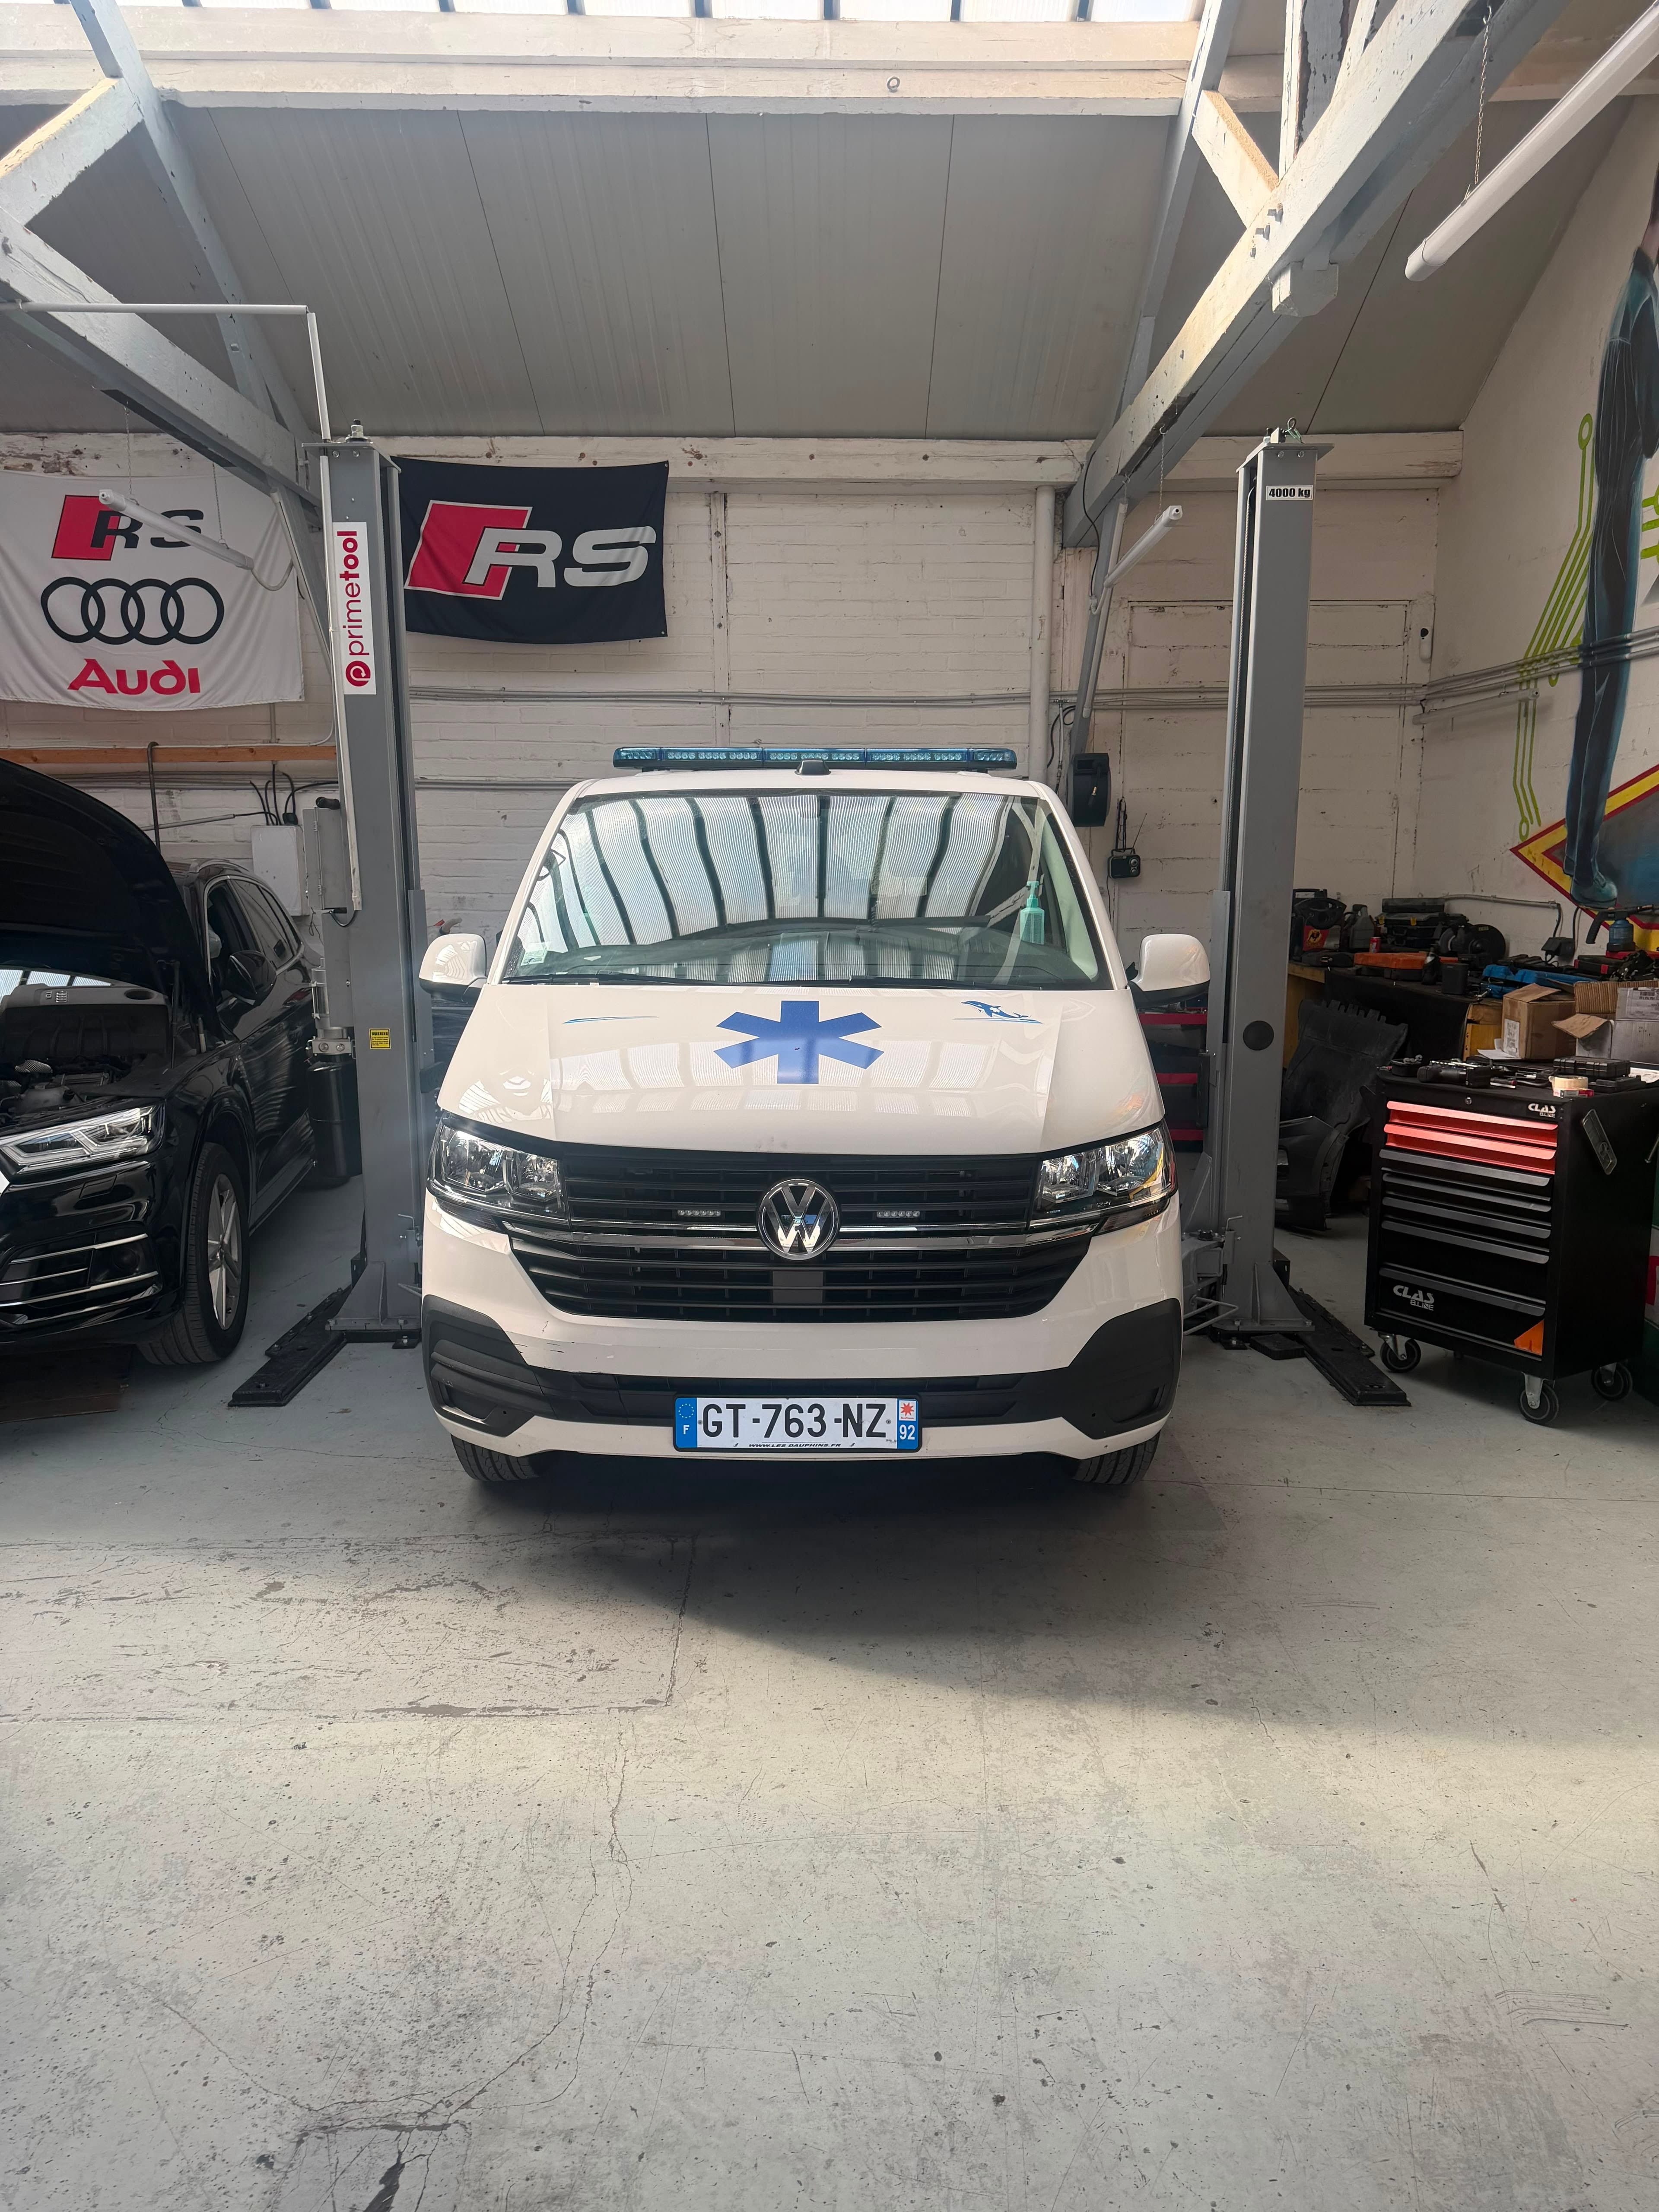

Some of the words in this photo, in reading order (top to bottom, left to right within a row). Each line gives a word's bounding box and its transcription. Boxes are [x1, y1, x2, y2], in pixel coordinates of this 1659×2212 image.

[1268, 488, 1296, 498] 4000
[1298, 488, 1310, 499] kg
[90, 509, 203, 549] RS
[462, 525, 656, 588] RS
[337, 531, 370, 656] primetool
[67, 658, 201, 695] Audi
[1528, 1103, 1556, 1113] CLAS
[1393, 1285, 1435, 1304] CLAS
[683, 1425, 690, 1435] F
[702, 1403, 886, 1438] GT-763-NZ
[899, 1424, 915, 1440] 92
